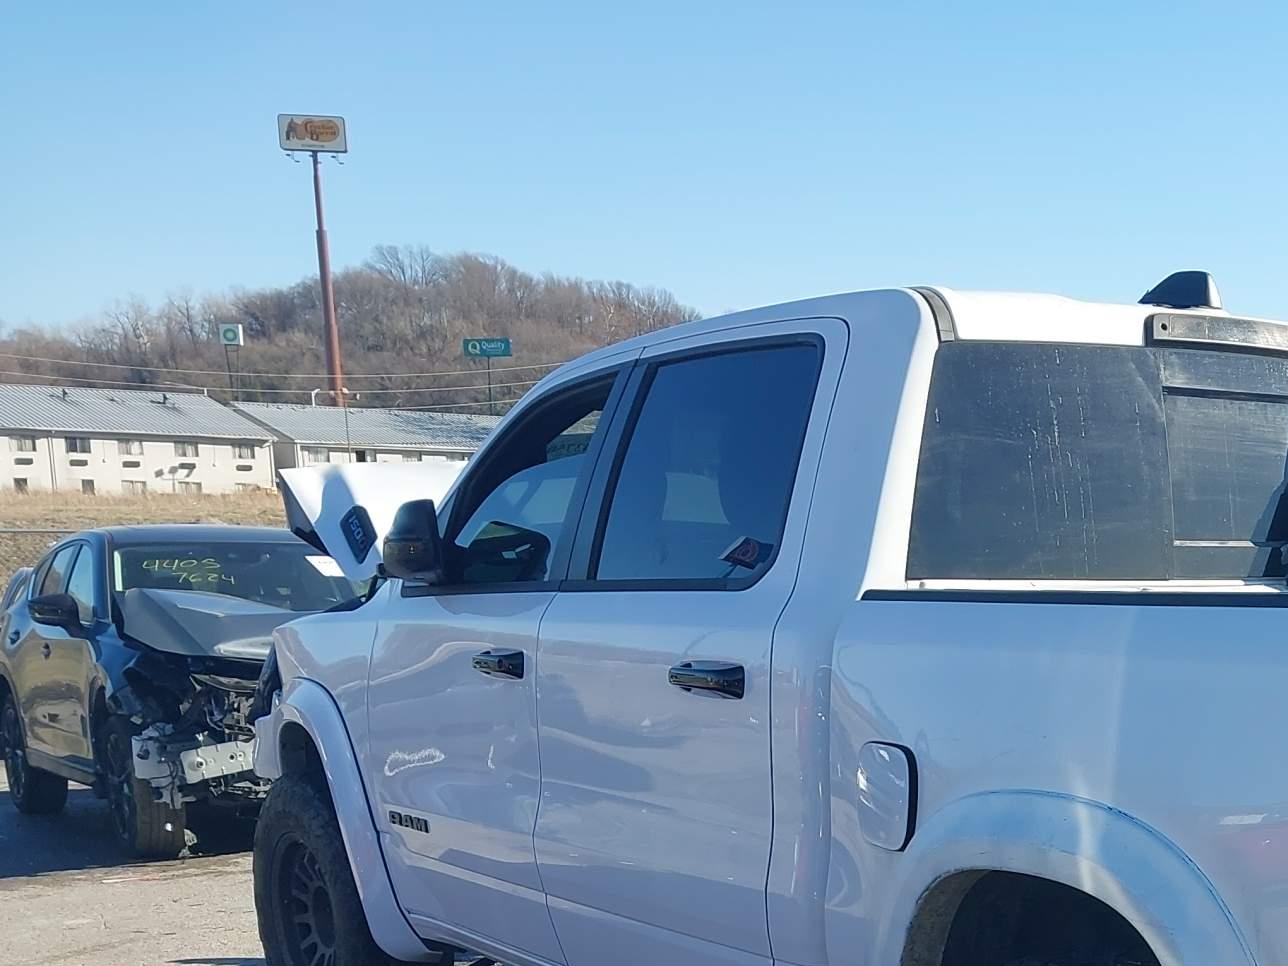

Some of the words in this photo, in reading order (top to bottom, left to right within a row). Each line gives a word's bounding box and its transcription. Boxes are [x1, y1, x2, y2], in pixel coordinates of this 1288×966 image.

[481, 340, 505, 350] Quality
[171, 572, 235, 584] 7624
[389, 810, 430, 834] RAM
